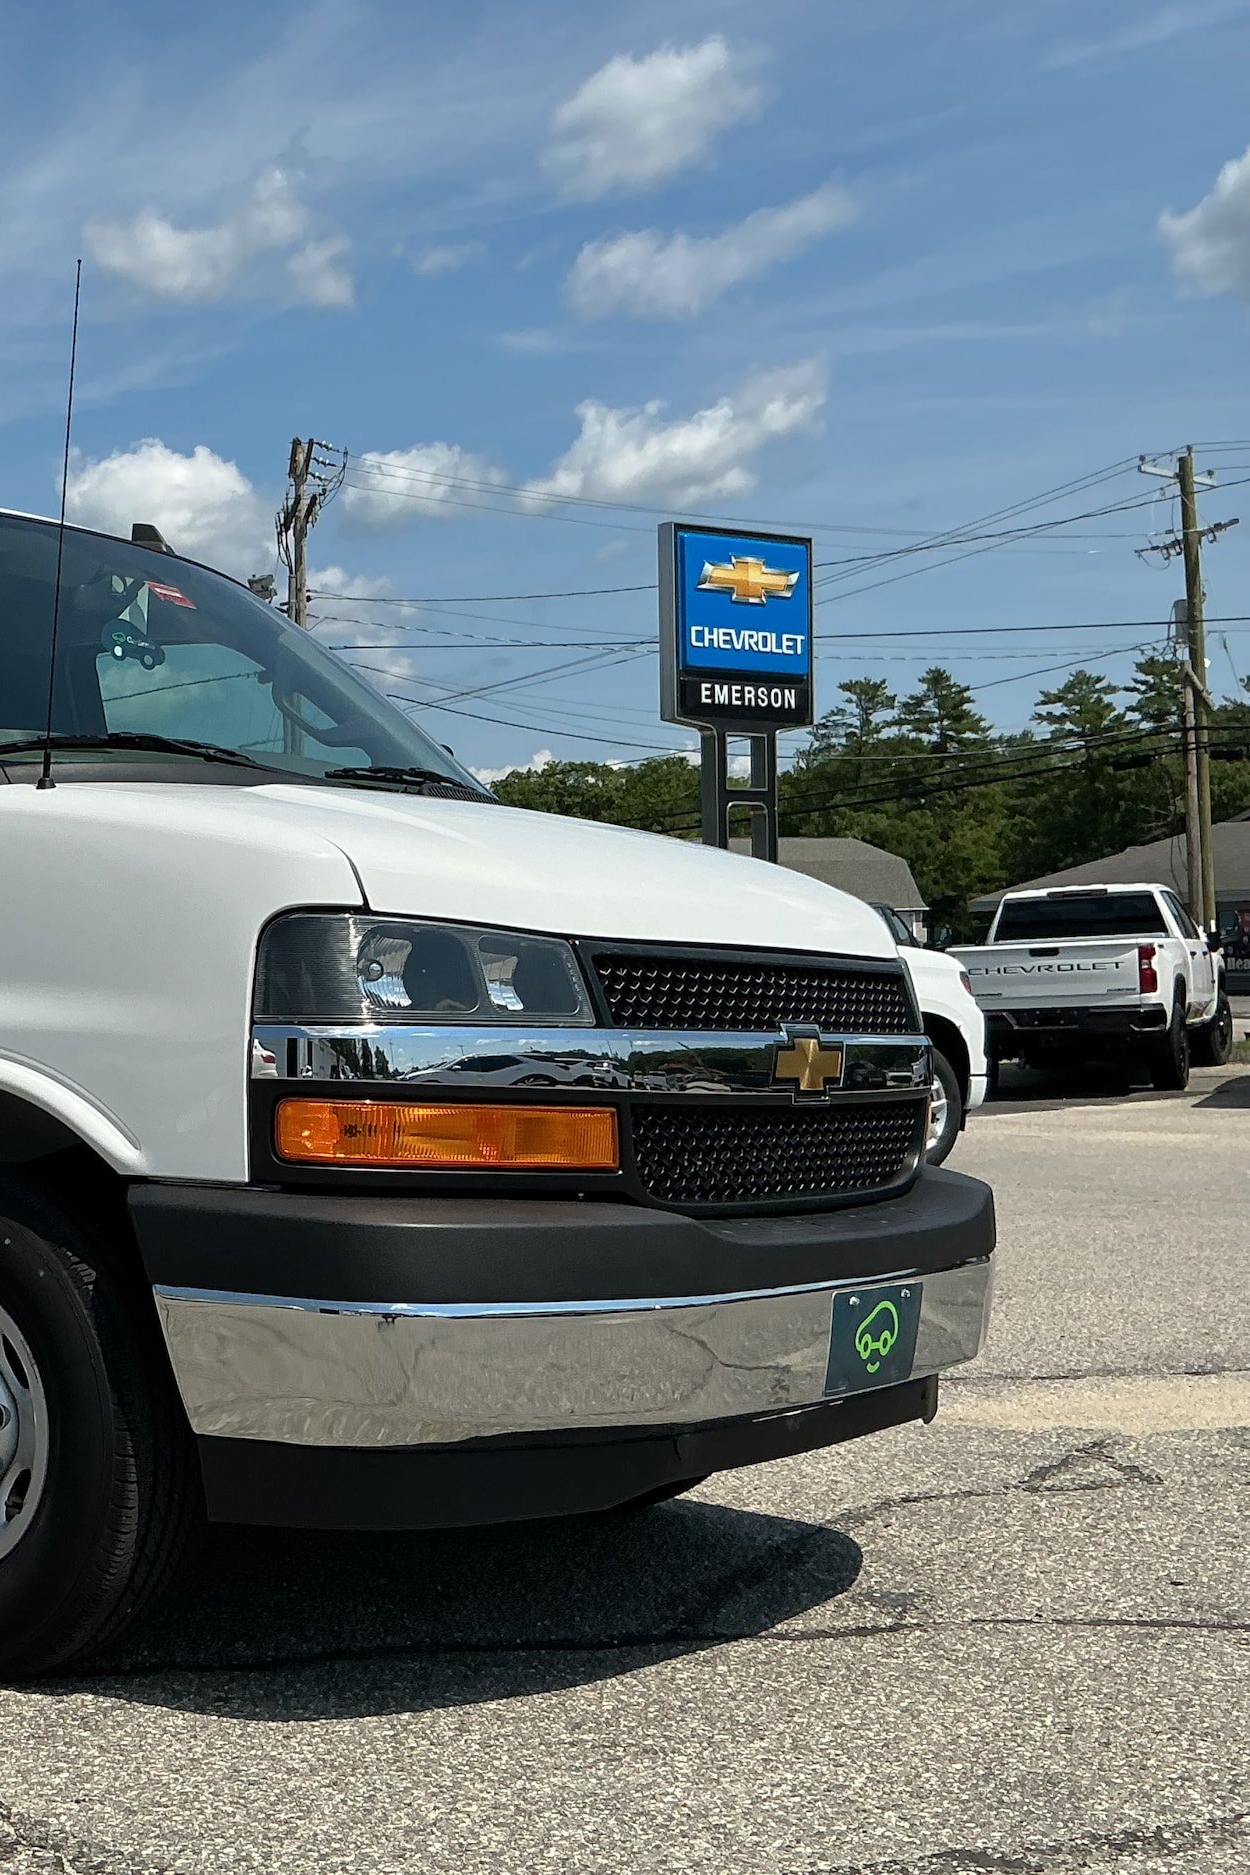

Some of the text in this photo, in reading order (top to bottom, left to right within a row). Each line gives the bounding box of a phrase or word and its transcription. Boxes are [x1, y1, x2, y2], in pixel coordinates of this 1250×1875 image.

[690, 625, 805, 655] CHEVROLET
[700, 683, 796, 710] EMERSON
[968, 961, 1124, 976] CHEVROLET
